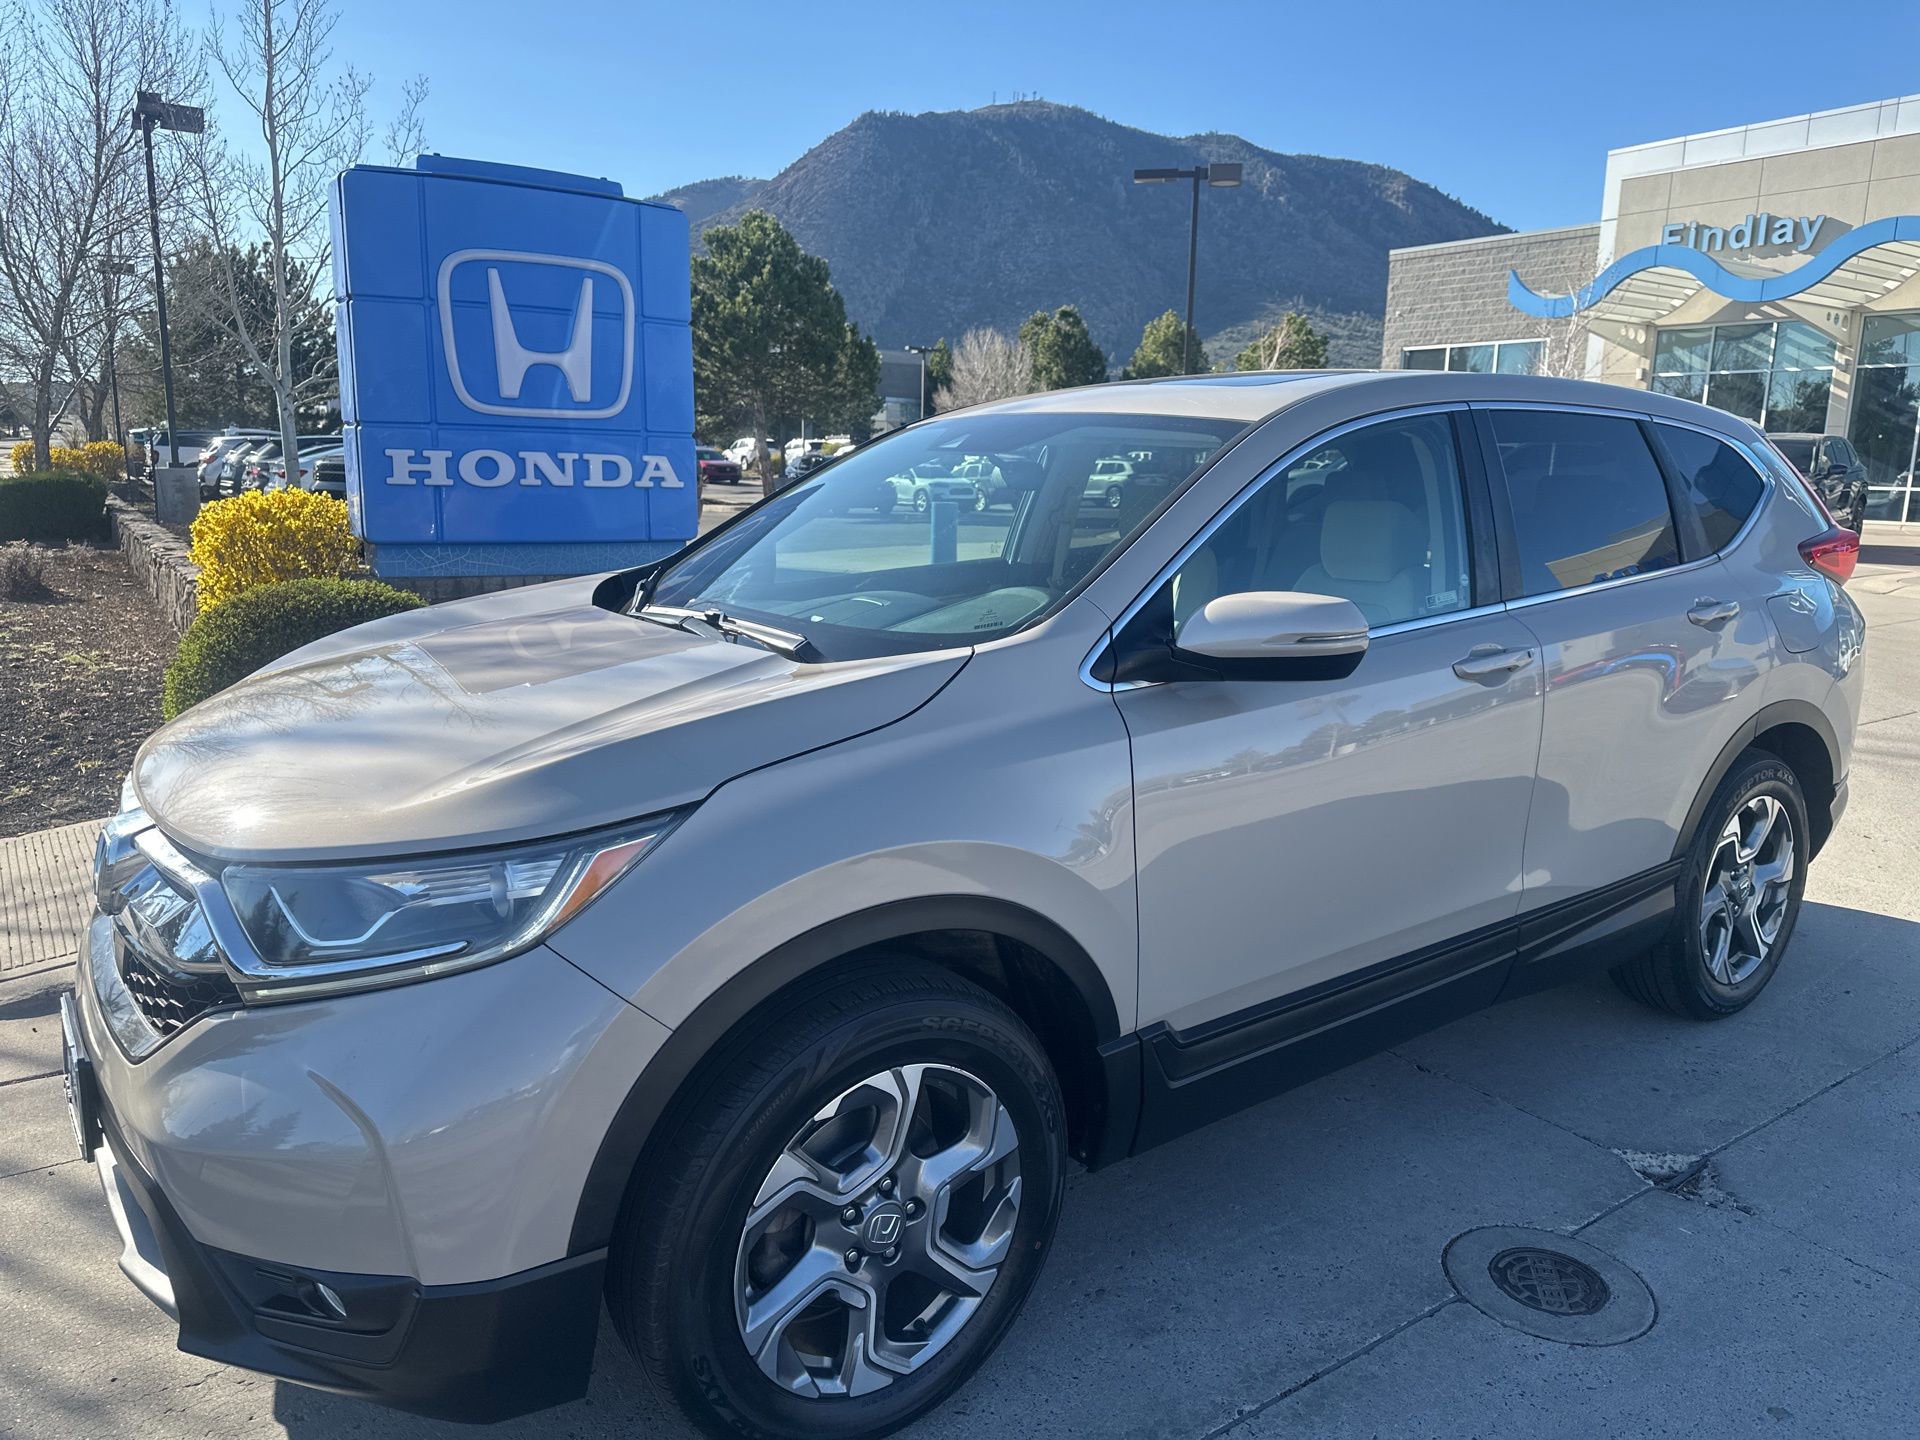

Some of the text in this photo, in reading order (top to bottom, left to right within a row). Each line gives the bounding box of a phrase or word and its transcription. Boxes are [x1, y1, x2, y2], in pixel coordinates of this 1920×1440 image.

[1662, 213, 1827, 252] Findlay
[385, 449, 685, 488] HONDA
[1778, 769, 1794, 786] 4XS
